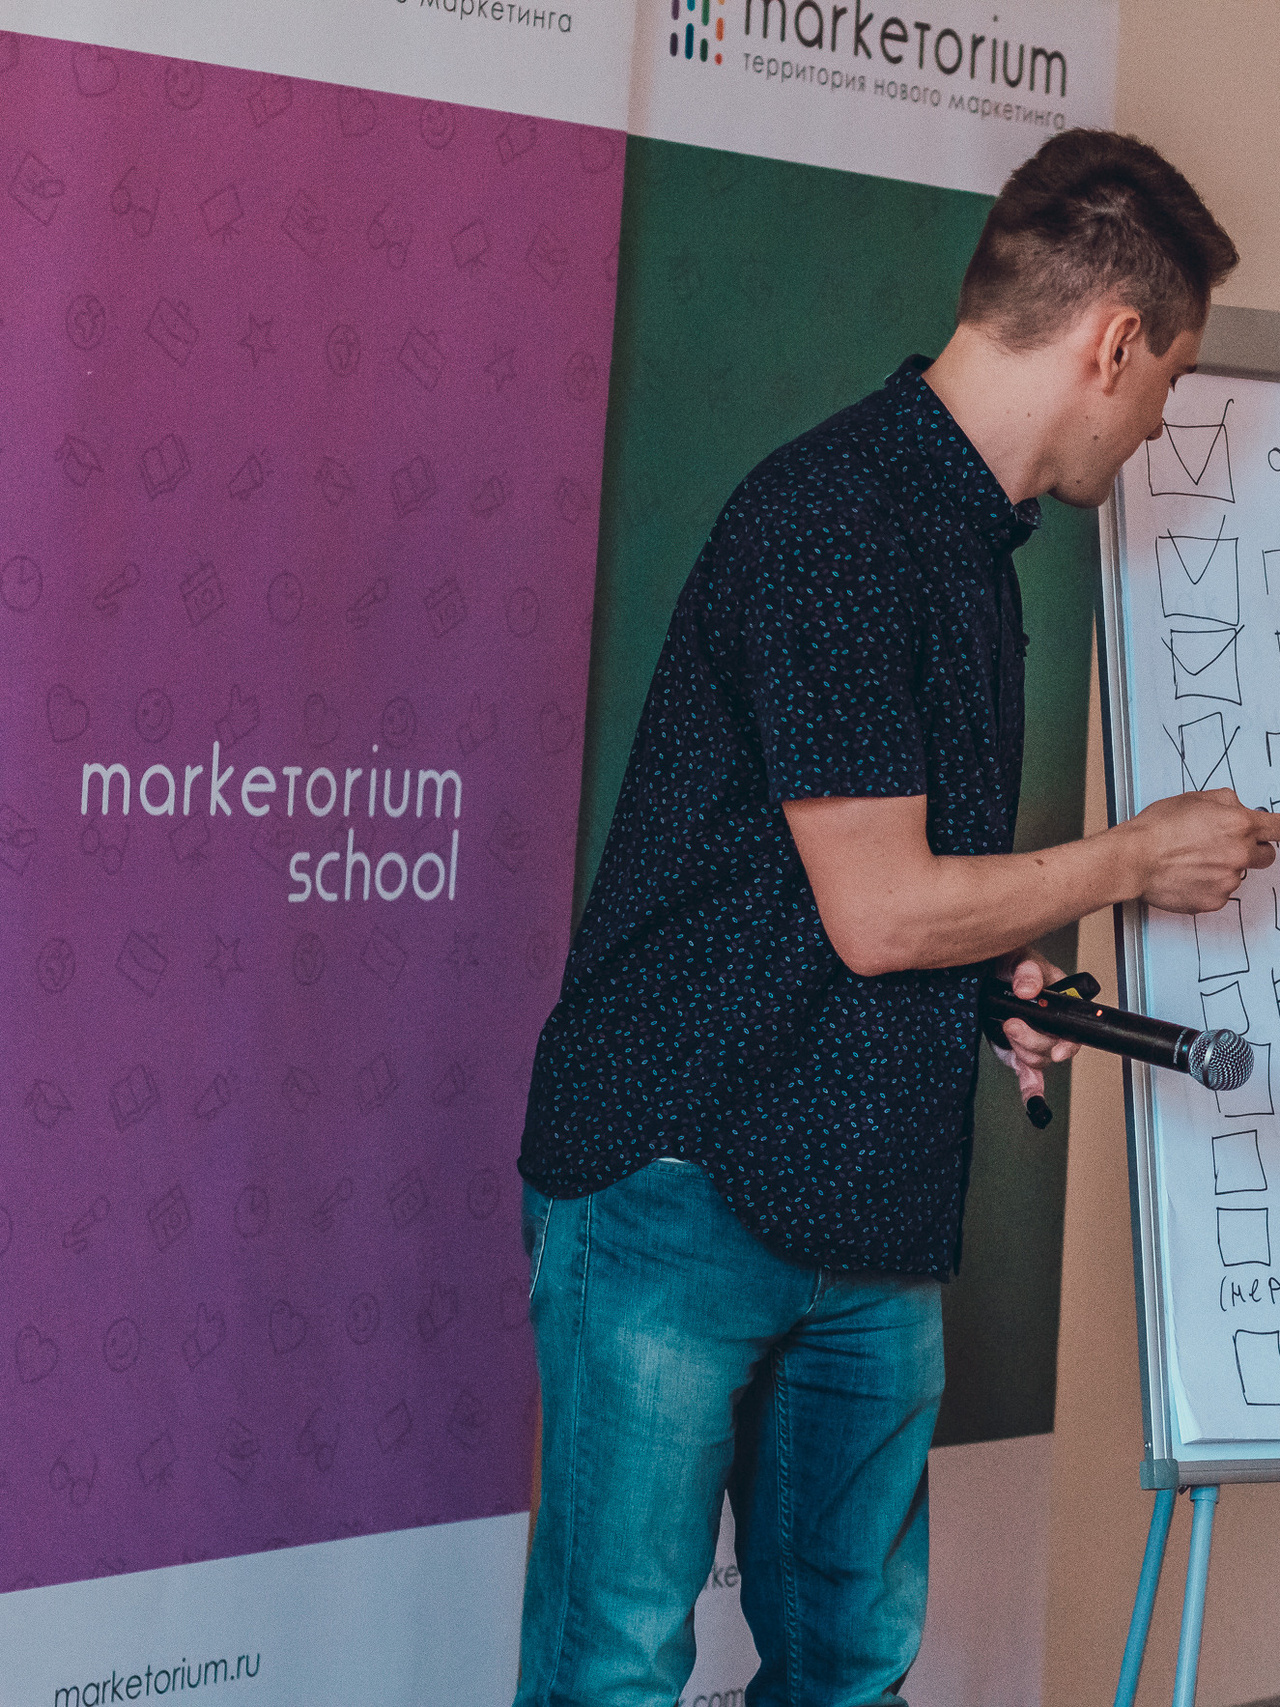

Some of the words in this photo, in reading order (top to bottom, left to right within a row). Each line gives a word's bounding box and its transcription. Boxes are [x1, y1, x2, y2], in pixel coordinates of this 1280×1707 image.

[743, 0, 1068, 98] marketorium
[743, 52, 867, 91] территория
[873, 77, 942, 107] нового
[948, 93, 1067, 131] маркетинга
[80, 740, 463, 819] marketorium
[287, 827, 460, 903] school
[54, 1653, 261, 1707] marketorium.ru
